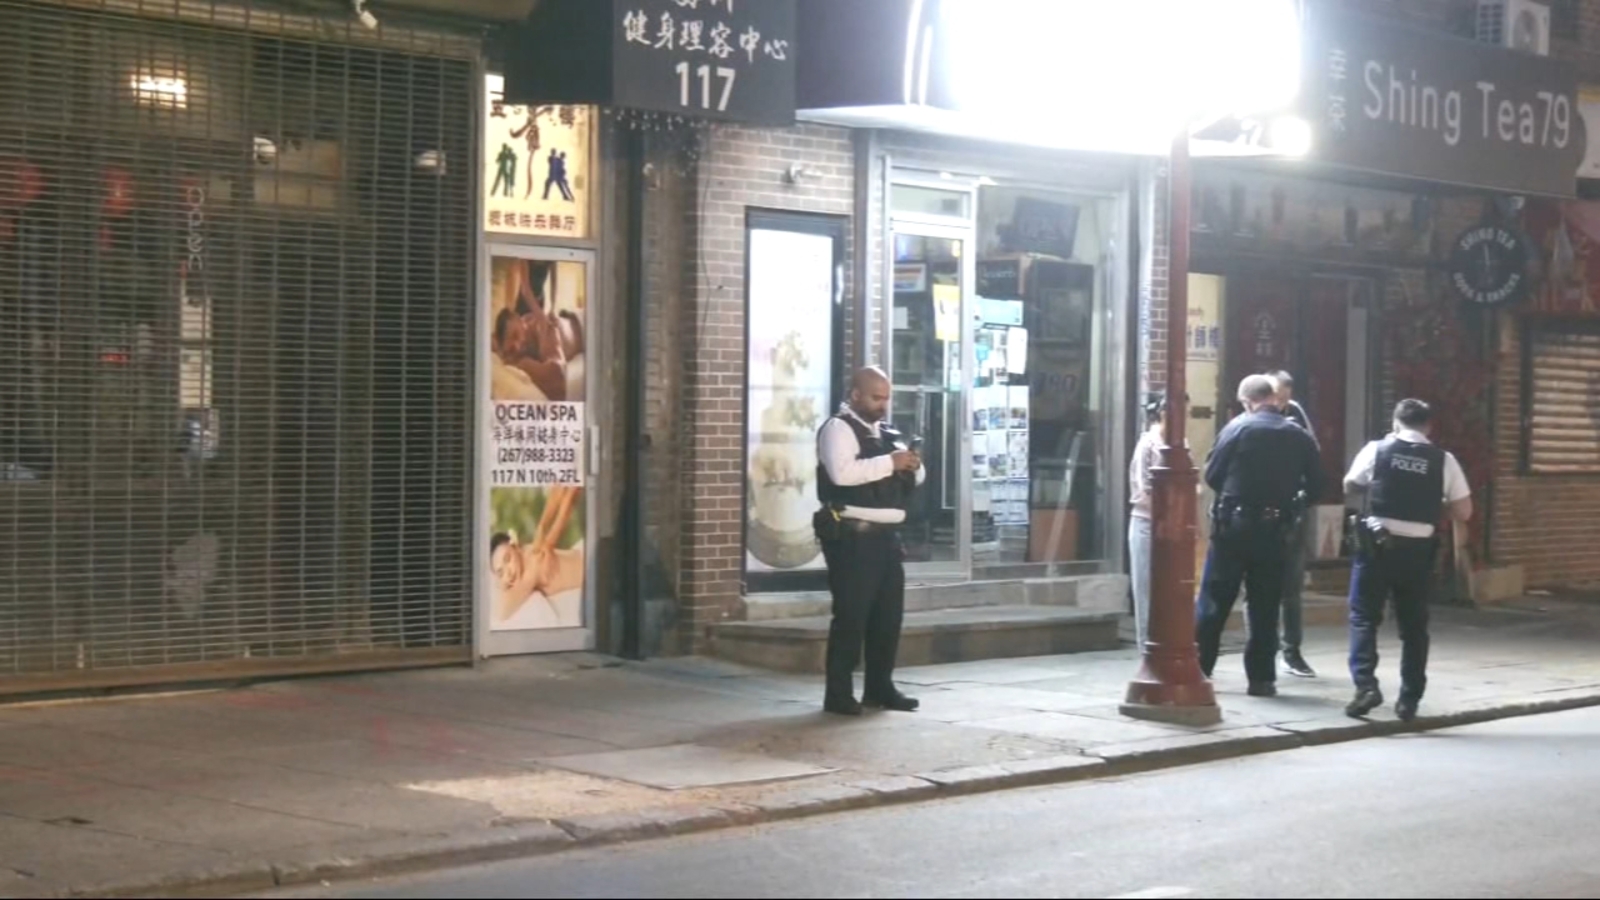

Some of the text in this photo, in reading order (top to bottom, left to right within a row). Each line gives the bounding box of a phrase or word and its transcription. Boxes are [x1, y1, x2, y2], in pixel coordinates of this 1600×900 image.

[623, 10, 788, 62] 健身理容中心
[675, 61, 735, 111] 117
[1363, 59, 1461, 145] Shing
[495, 404, 577, 421] OCEAN SPA
[497, 448, 575, 465] (267)988-3323
[1391, 458, 1427, 474] POLICE
[492, 469, 580, 484] 117 N 10th 2FL
